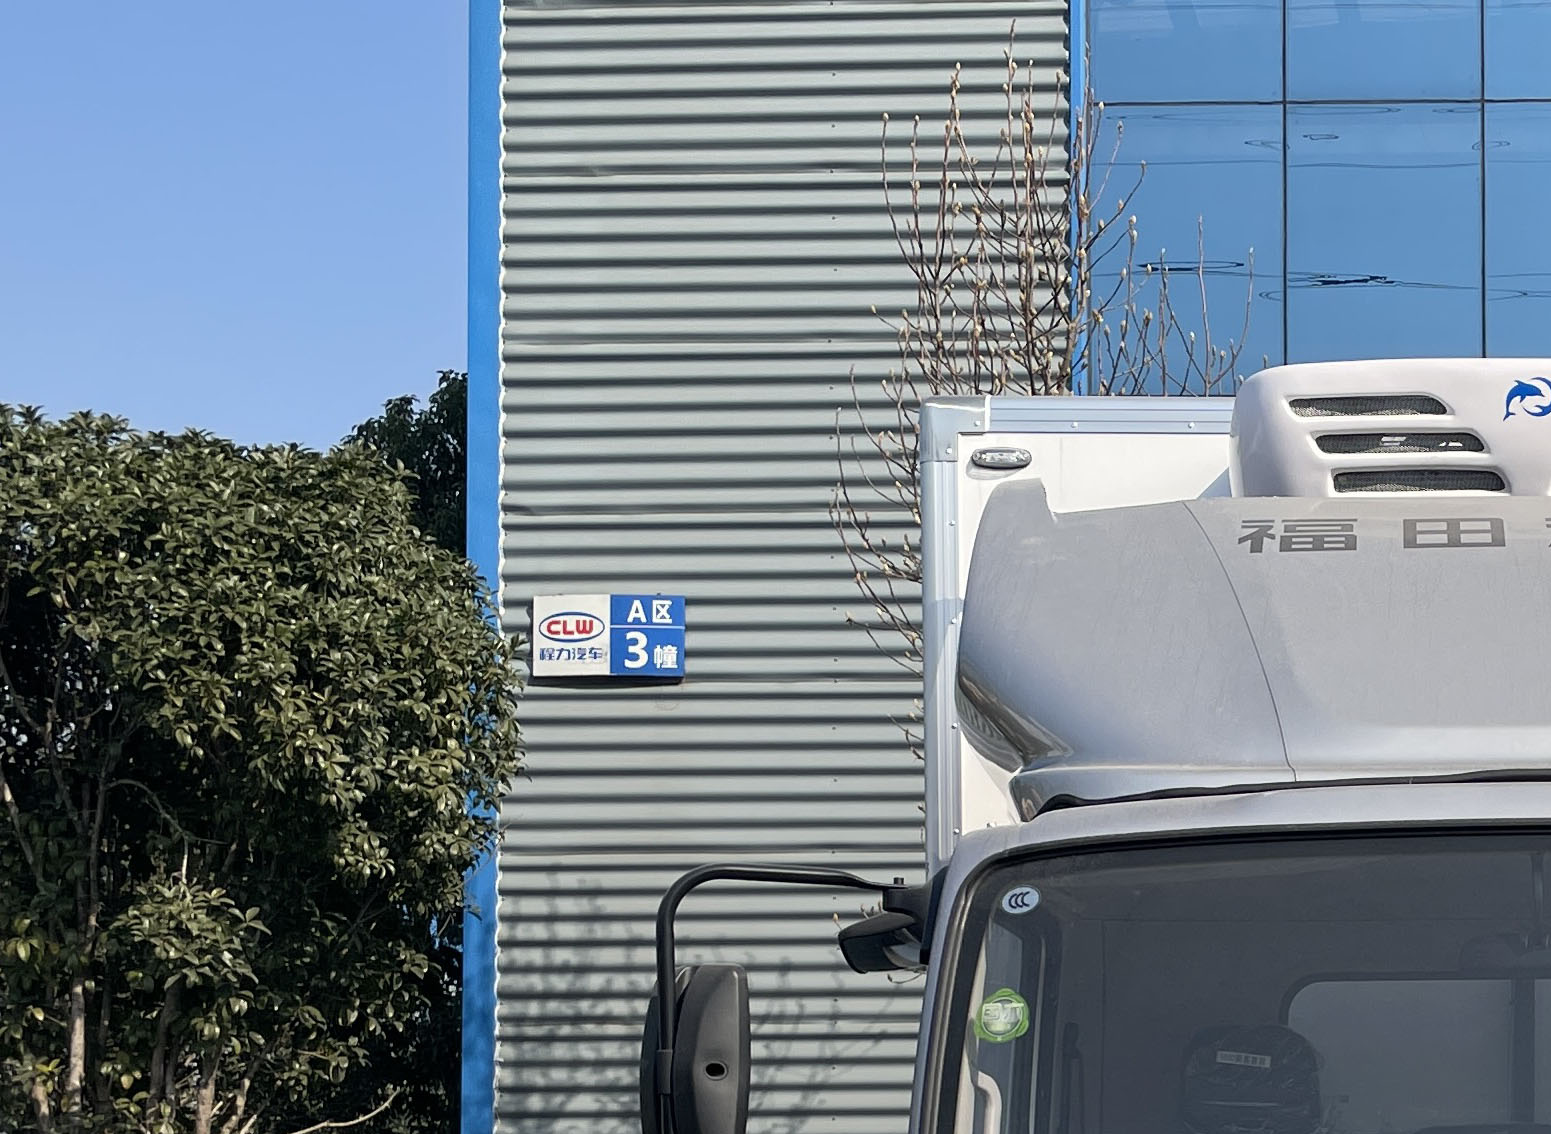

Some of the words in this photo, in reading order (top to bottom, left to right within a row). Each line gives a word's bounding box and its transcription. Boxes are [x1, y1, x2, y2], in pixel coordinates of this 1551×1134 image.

[627, 600, 673, 624] A区
[546, 619, 594, 636] CLW
[539, 647, 603, 661] 程力汽车
[624, 631, 678, 669] 3幢
